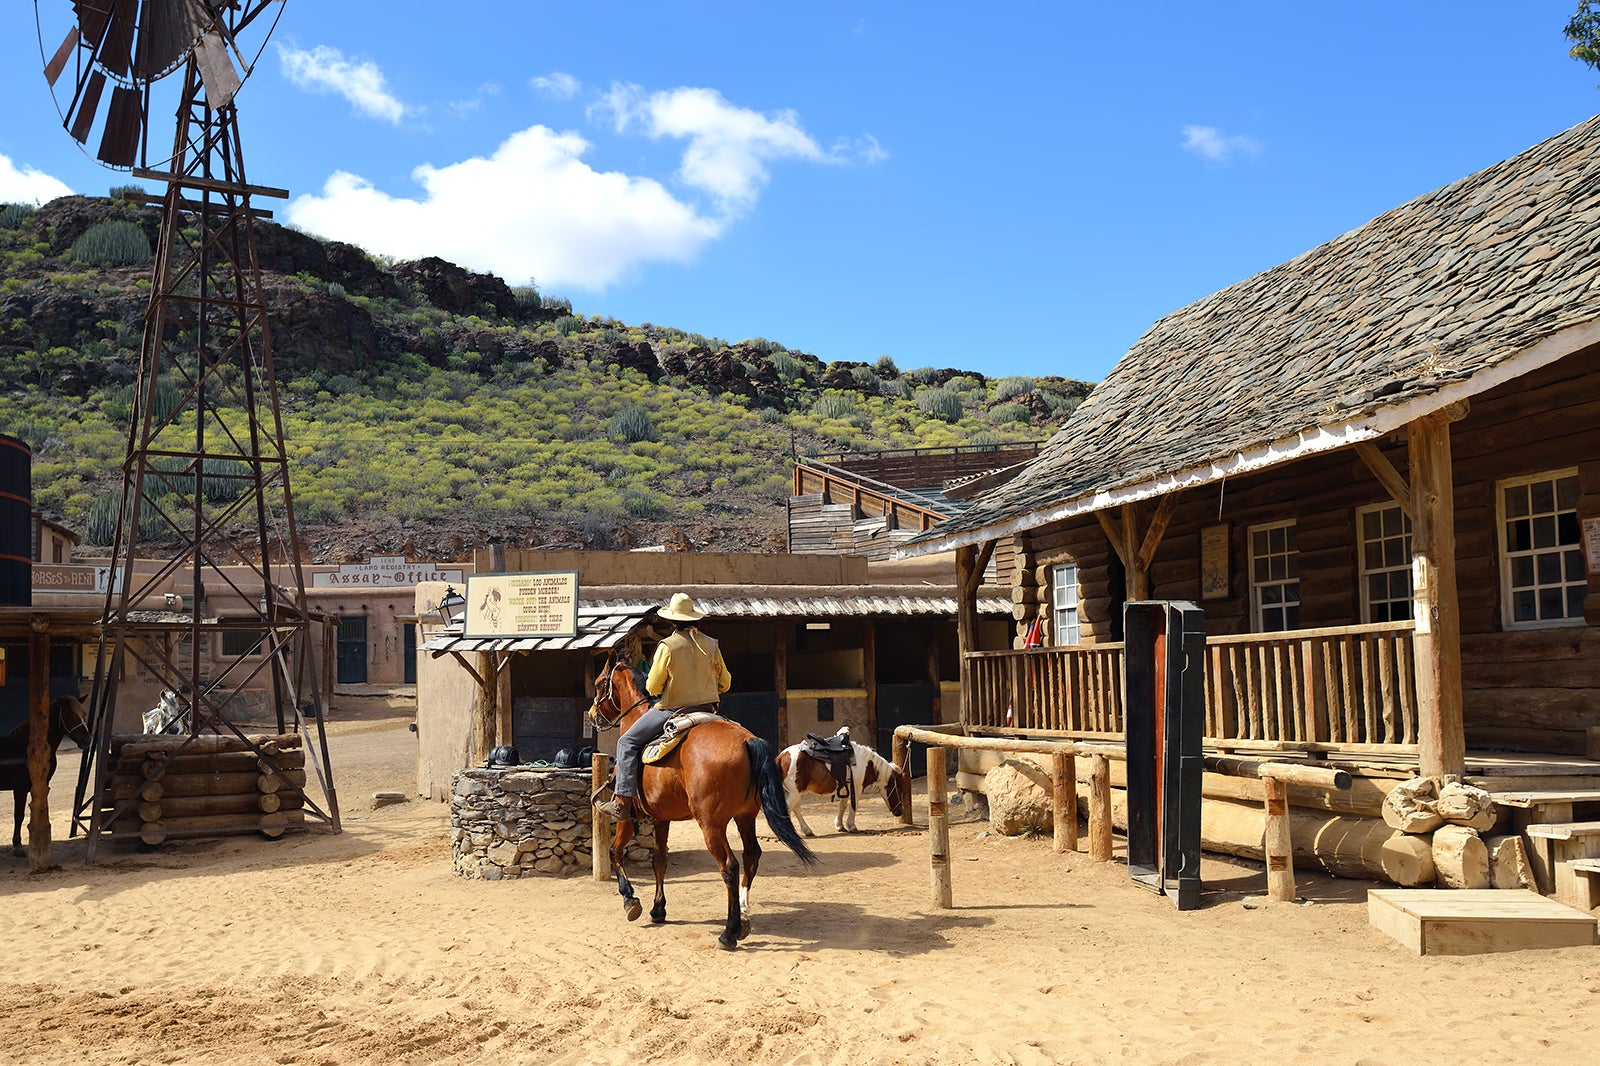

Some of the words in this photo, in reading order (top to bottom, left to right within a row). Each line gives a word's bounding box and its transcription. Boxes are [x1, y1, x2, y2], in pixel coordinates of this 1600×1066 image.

[71, 572, 94, 585] RENT
[543, 577, 568, 585] ANIMALES
[519, 587, 537, 595] PUEDEN
[538, 596, 547, 604] THE
[548, 595, 571, 604] ANIMALS
